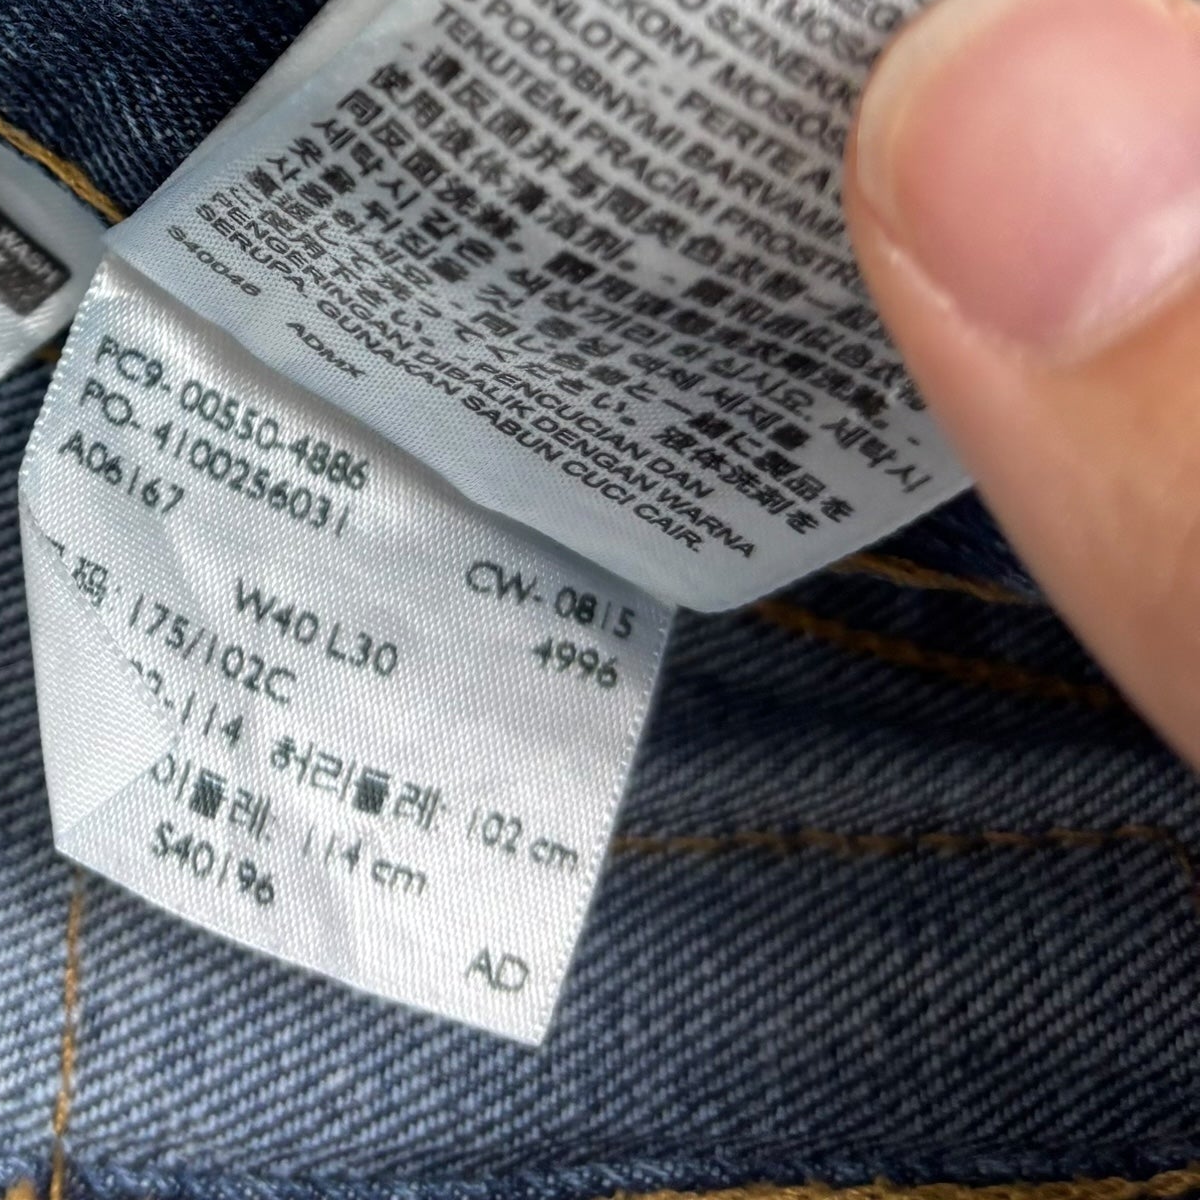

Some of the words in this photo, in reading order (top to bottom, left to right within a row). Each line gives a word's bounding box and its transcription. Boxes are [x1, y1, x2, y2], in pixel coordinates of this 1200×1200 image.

[421, 0, 591, 128] TEKUTÉM
[708, 59, 863, 156] MOSÓS
[672, 88, 808, 176] PERTE
[193, 202, 317, 298] SERUPA.
[313, 297, 463, 397] GUNAKAN
[456, 391, 565, 463] SABUN
[558, 456, 637, 507] CUCI
[630, 500, 710, 553] CAIR.
[209, 190, 413, 352] PENGERINGAN
[412, 349, 537, 420] DIBALIK
[530, 413, 659, 494] DENGAN
[652, 486, 760, 558] WARNA
[286, 321, 366, 379] ADMX
[57, 429, 185, 514] A06167
[180, 378, 370, 492] 00550-4886
[471, 358, 652, 462] PENCUCIAN
[645, 454, 715, 501] DAN
[153, 420, 349, 538] 4100256031
[127, 593, 297, 704] 175/102C
[237, 576, 320, 646] W40
[324, 622, 398, 677] L30
[554, 585, 636, 640] 0815
[531, 635, 619, 690] 4996
[151, 820, 275, 906] S40196
[302, 824, 362, 874] 114
[371, 857, 428, 897] cm
[466, 807, 524, 855] 102
[530, 838, 579, 870] cm
[464, 946, 530, 993] AD
